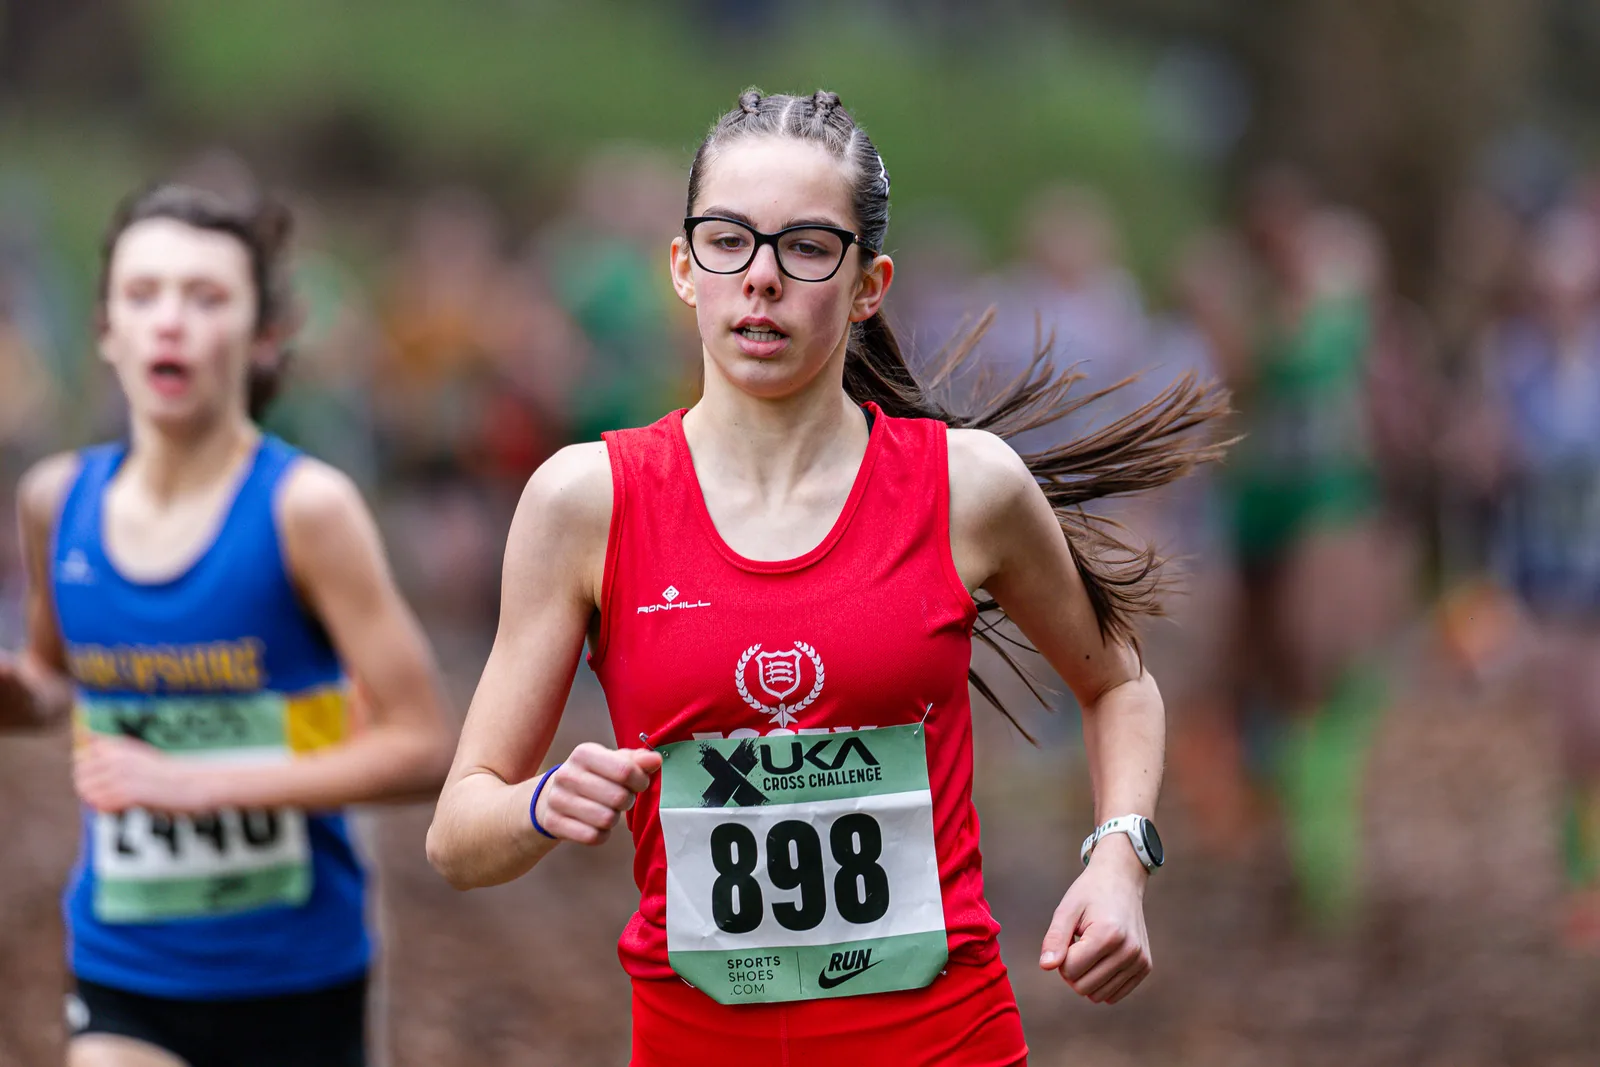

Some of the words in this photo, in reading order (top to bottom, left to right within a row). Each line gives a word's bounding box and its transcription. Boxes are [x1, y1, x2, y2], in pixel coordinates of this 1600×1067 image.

[637, 599, 711, 614] RONHILL
[760, 737, 880, 775] UKA
[763, 775, 805, 791] CROSS
[809, 767, 882, 788] CHALLENGE
[710, 813, 890, 934] 898
[727, 956, 781, 969] SPORTS
[828, 948, 873, 972] RUN
[728, 969, 774, 982] SHOES
[730, 984, 765, 996] .COM
